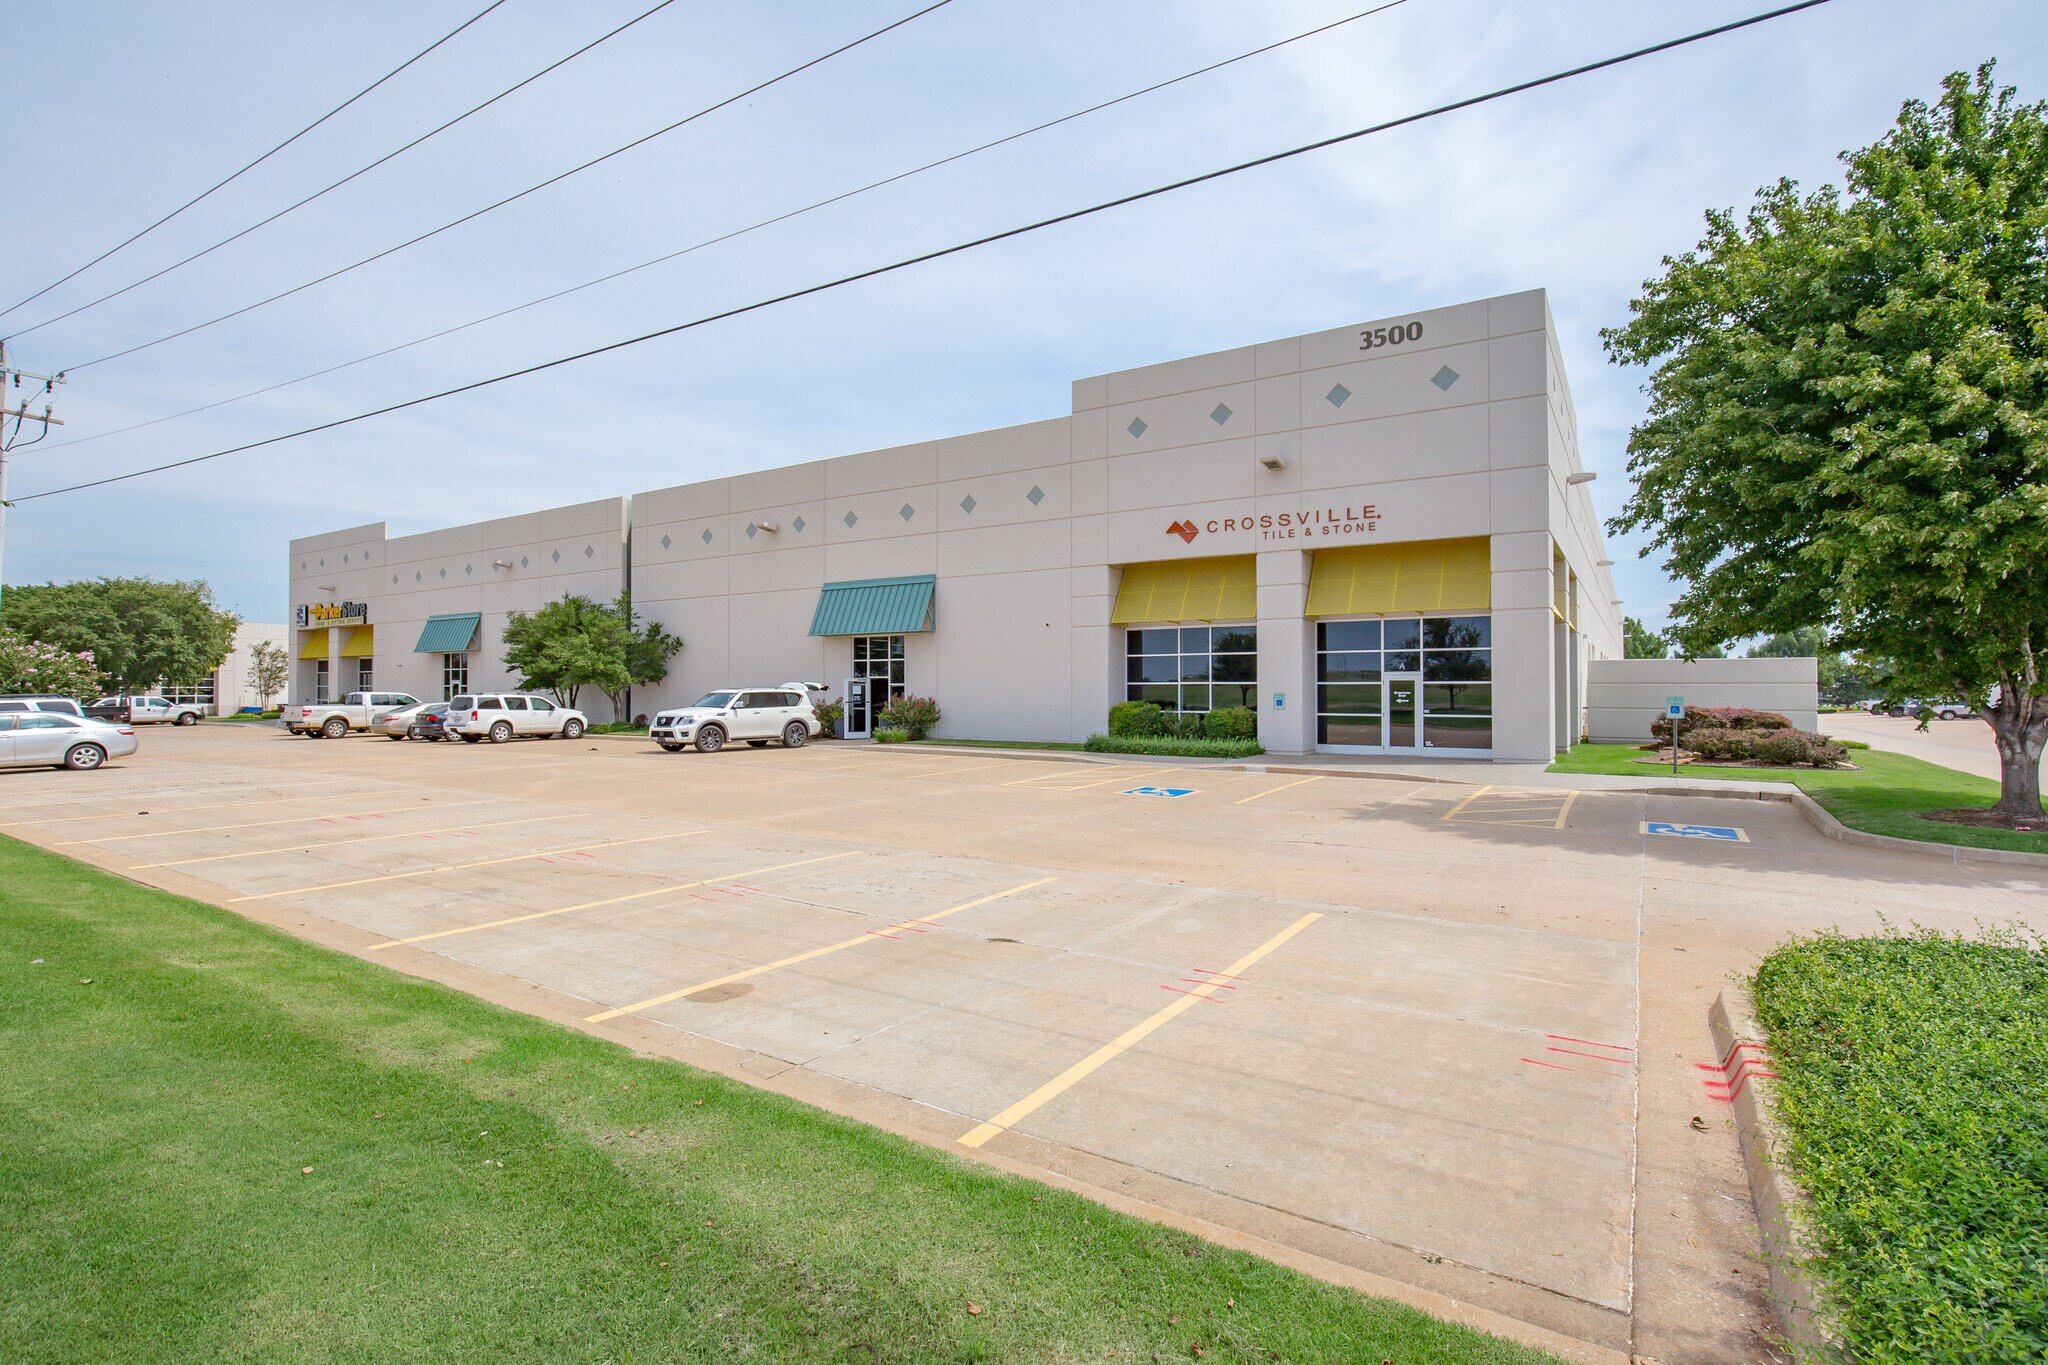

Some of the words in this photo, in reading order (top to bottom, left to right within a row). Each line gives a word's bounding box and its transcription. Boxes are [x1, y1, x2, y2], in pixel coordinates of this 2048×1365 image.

[1359, 321, 1423, 350] 3500
[1262, 528, 1295, 540] TILE
[1304, 527, 1313, 537] &
[1322, 521, 1376, 535] STONE
[1399, 662, 1405, 670] A
